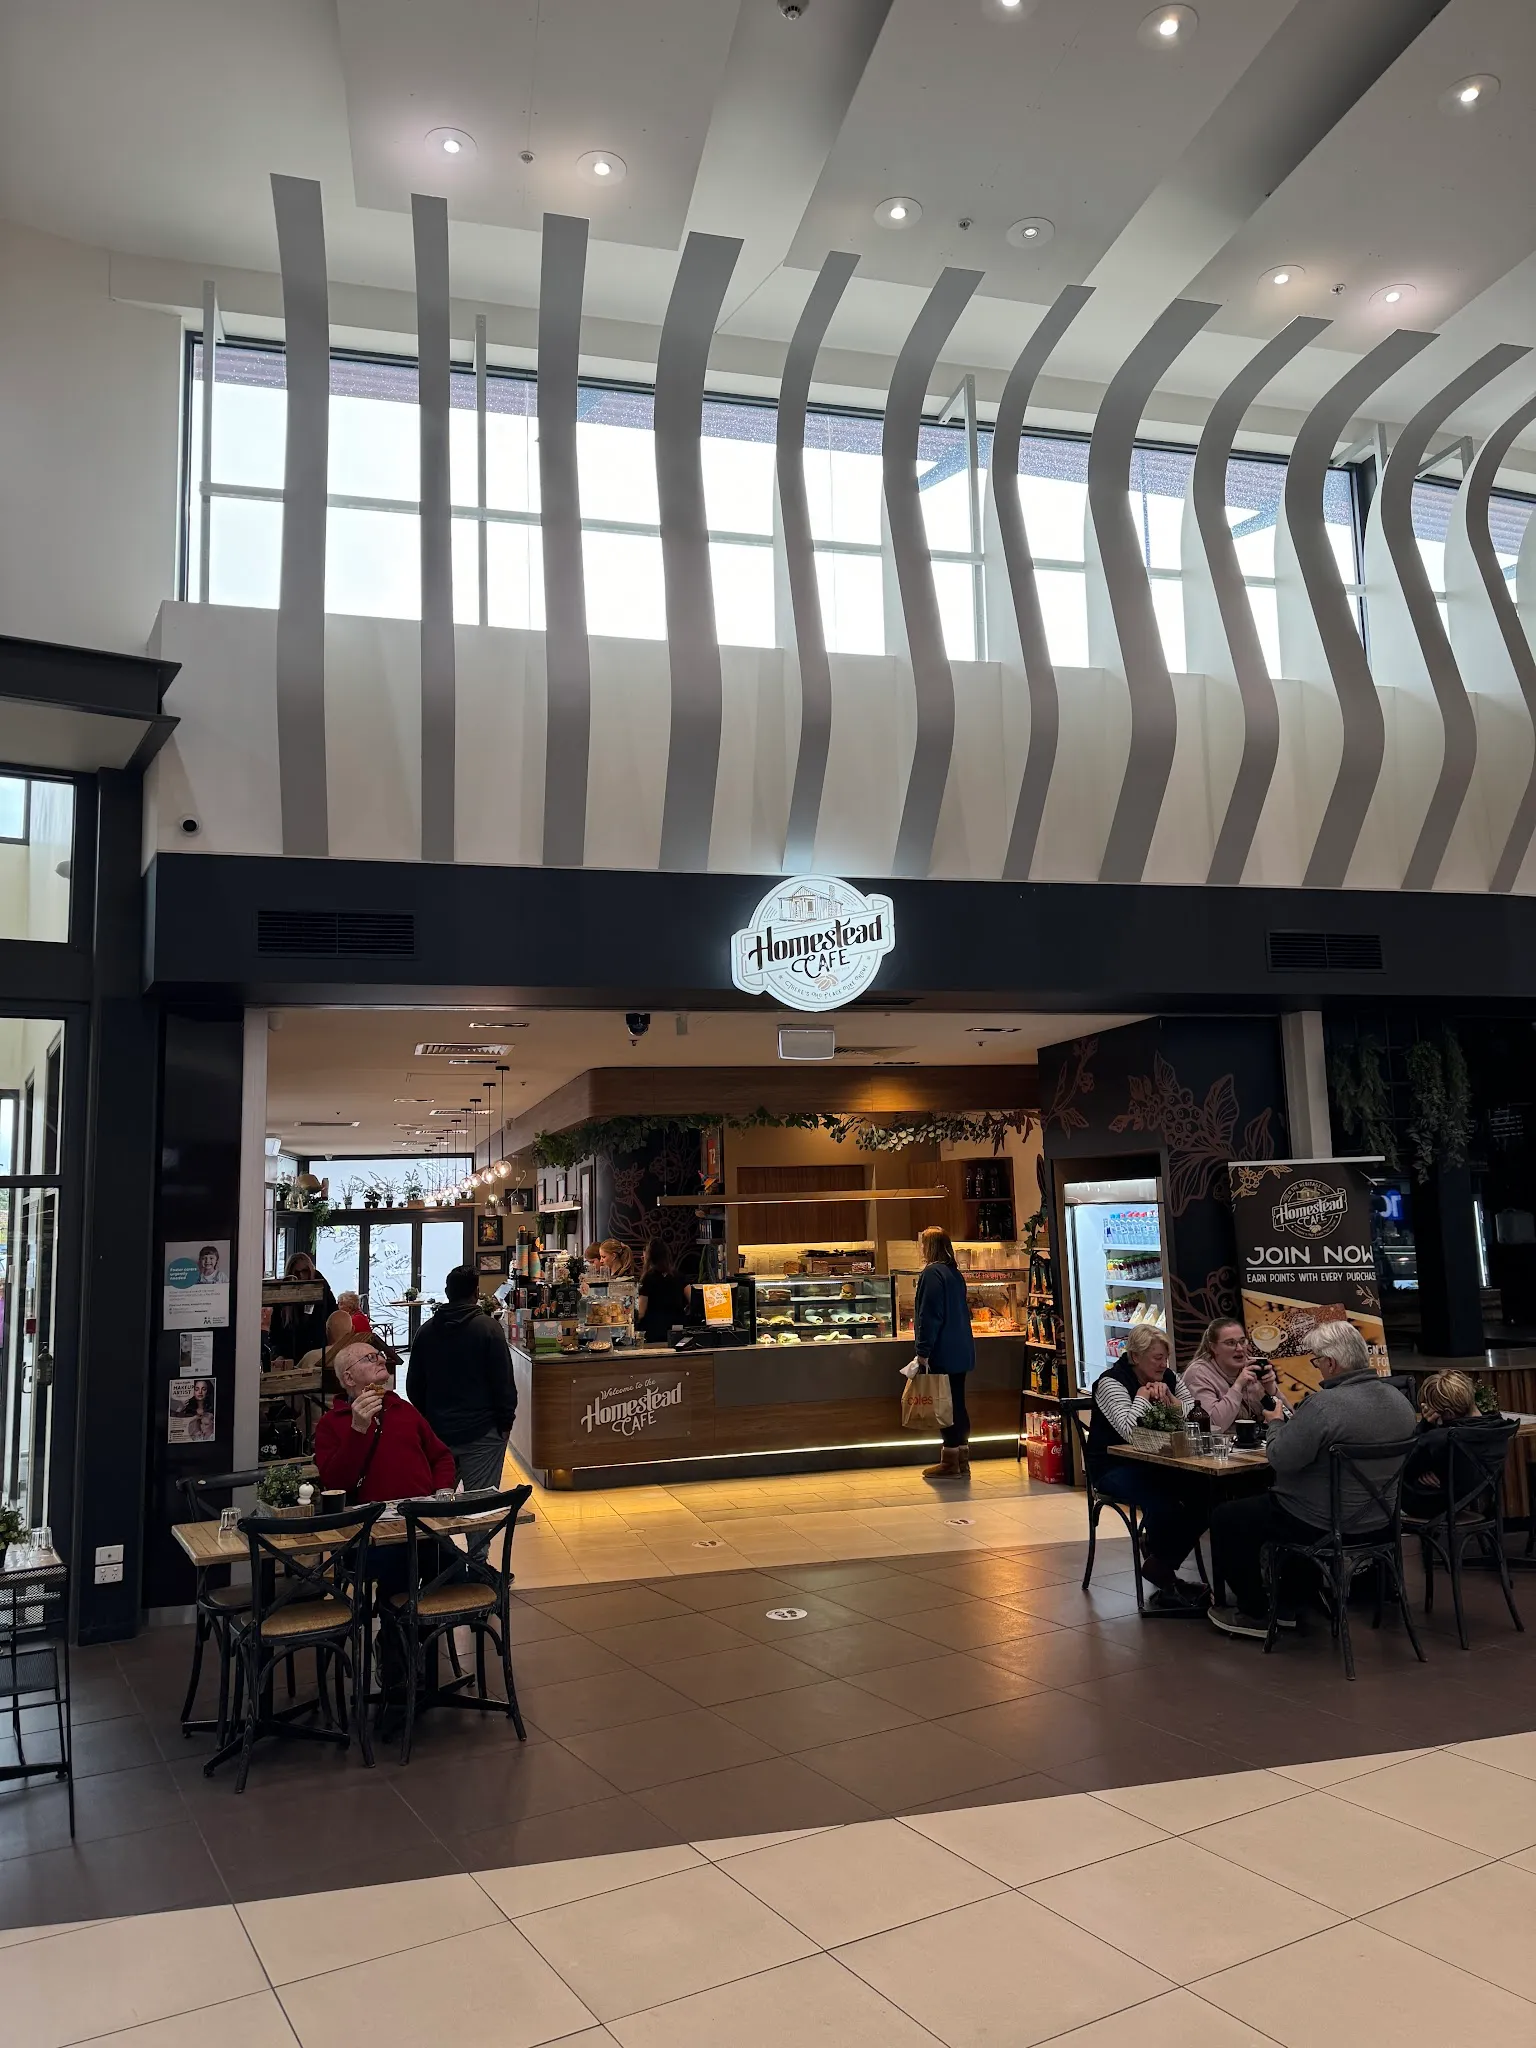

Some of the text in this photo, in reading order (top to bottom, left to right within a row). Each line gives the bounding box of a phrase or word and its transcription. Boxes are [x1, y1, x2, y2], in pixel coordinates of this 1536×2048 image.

[748, 914, 883, 971] Homestead
[791, 948, 851, 979] CAFE
[1276, 1195, 1344, 1224] Homestead
[1297, 1213, 1328, 1228] CAFE
[1246, 1244, 1374, 1265] JOIN NOW
[1246, 1271, 1377, 1283] EARN POINTS WITH EVERY PURCHAS
[600, 1378, 657, 1400] Welcome to the
[907, 1394, 934, 1406] coles
[580, 1382, 682, 1433] Homestead
[611, 1410, 657, 1437] CAFE
